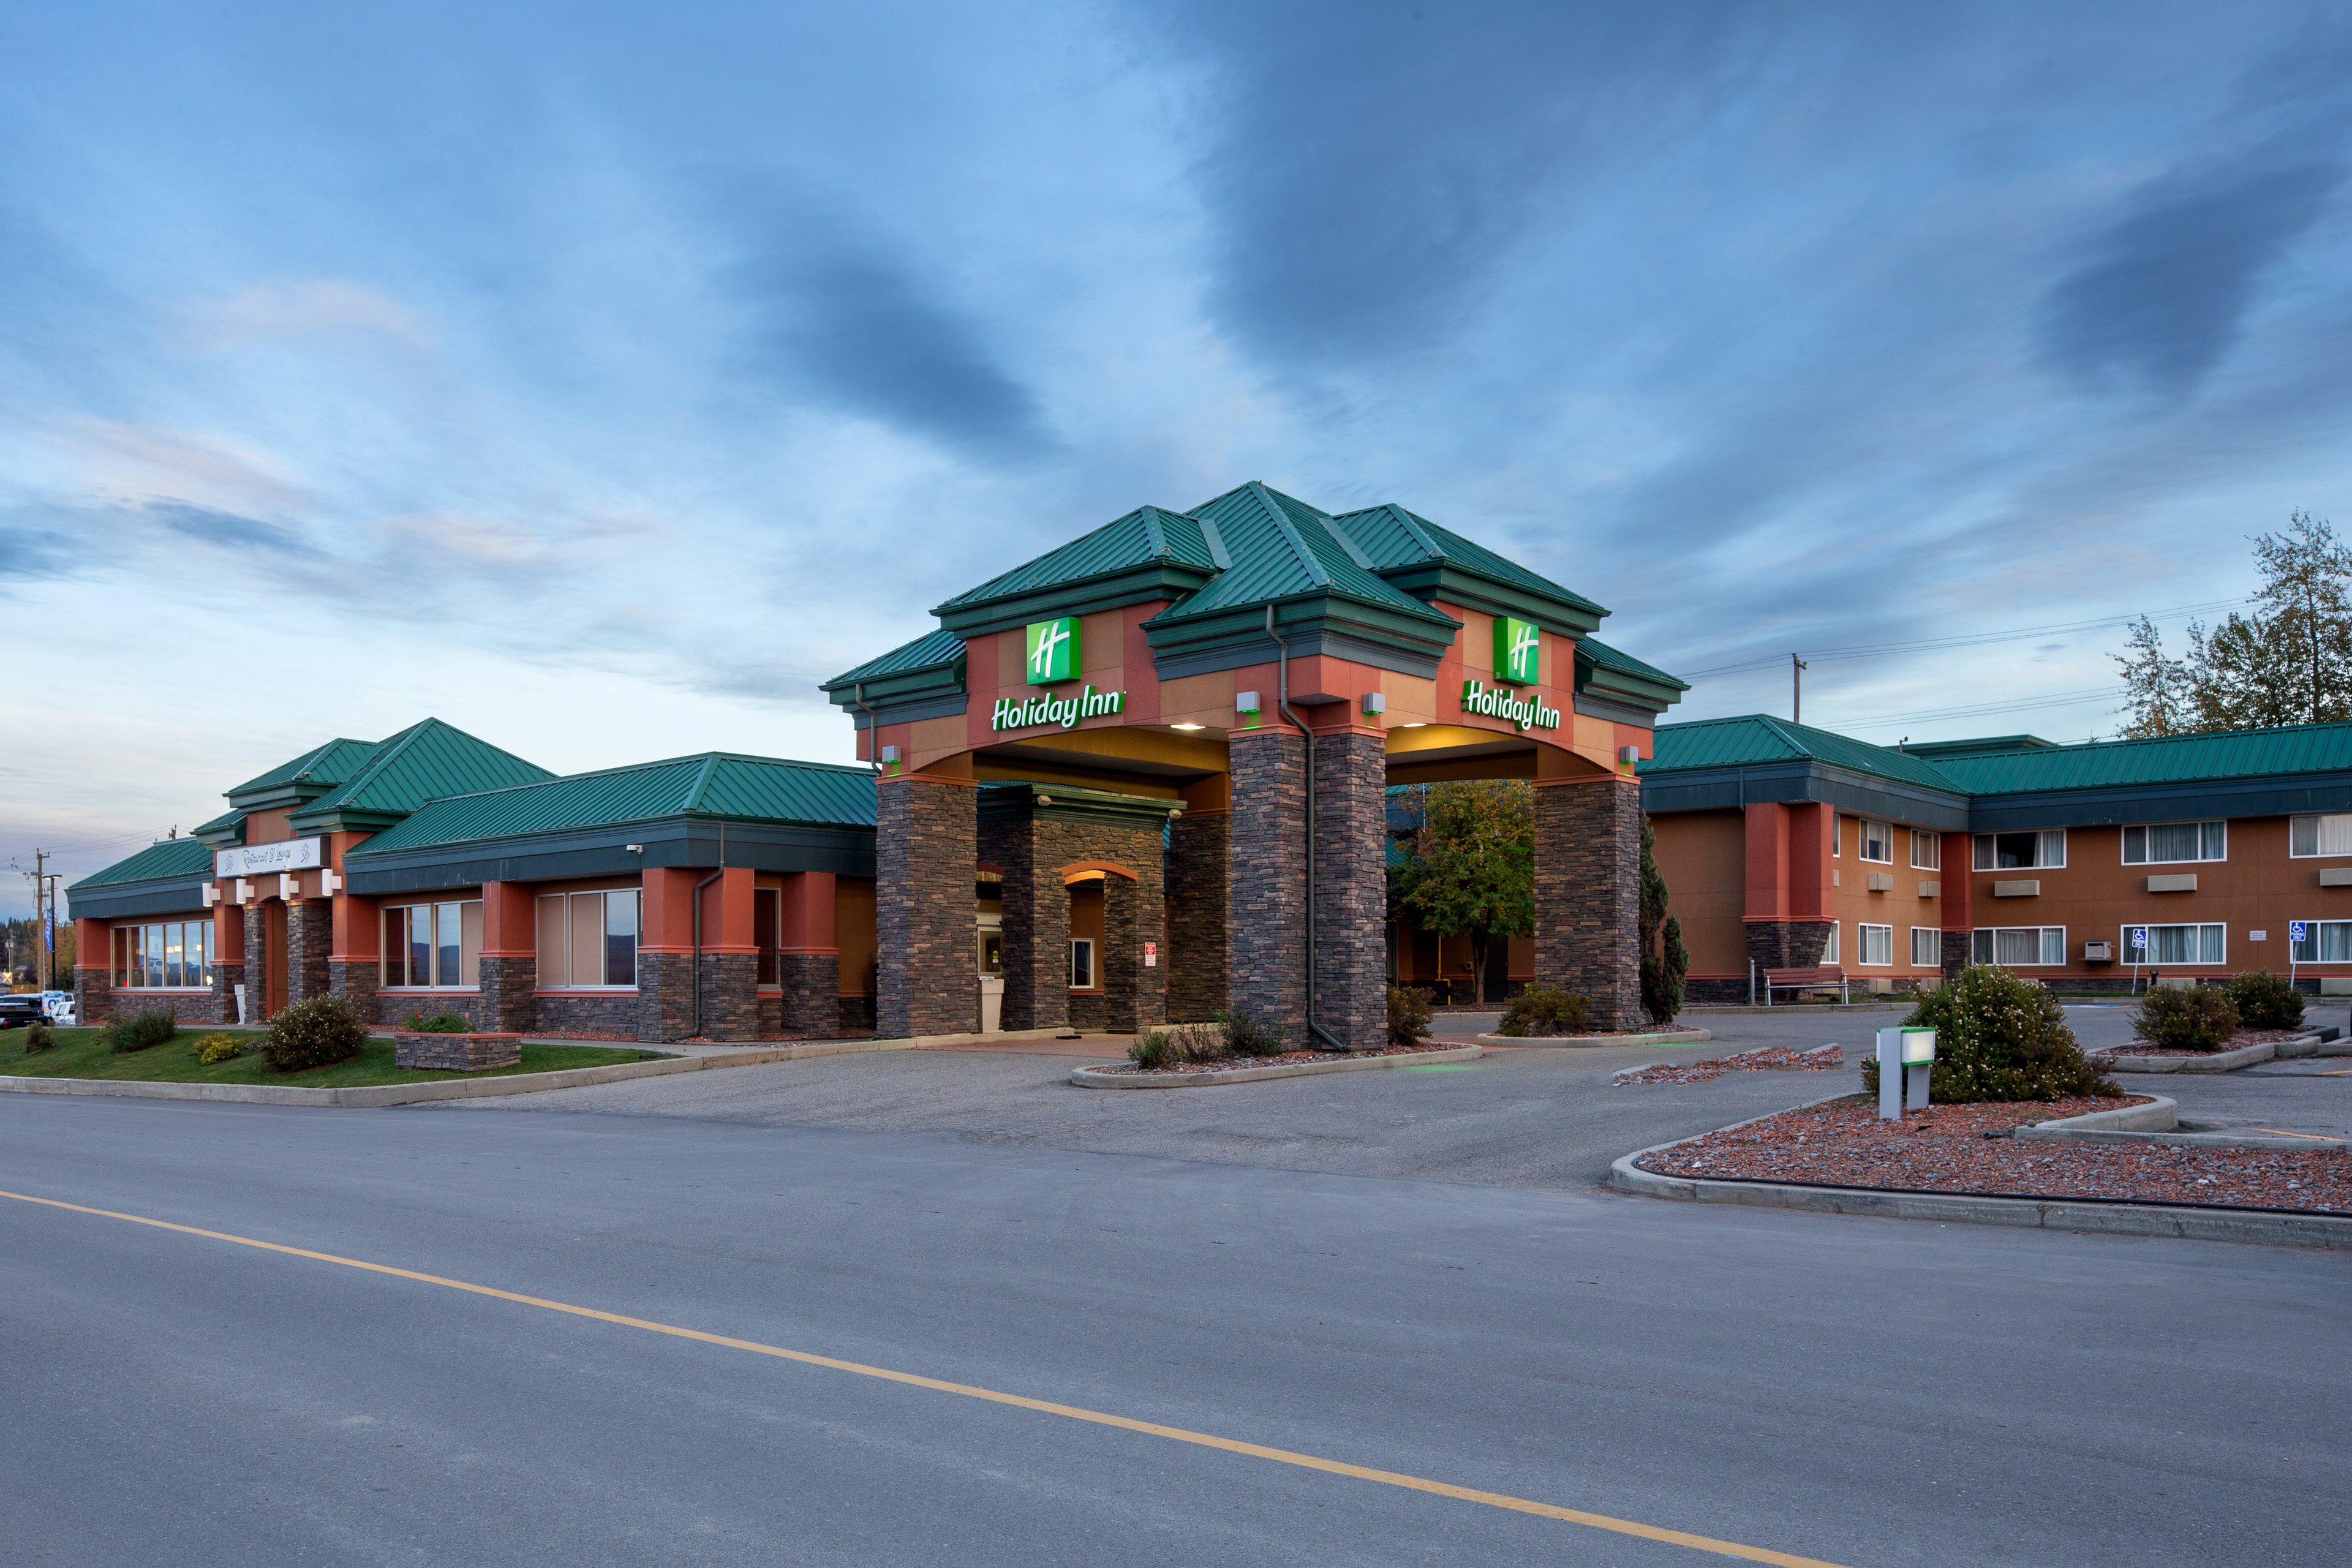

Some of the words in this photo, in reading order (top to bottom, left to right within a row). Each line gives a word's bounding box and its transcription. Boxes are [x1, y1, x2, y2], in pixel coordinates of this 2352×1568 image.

[991, 692, 1079, 730] Holiday
[1081, 685, 1120, 717] Inn
[1468, 680, 1534, 730] Holiday
[1536, 695, 1560, 729] Inn
[242, 850, 268, 869] Restaurant
[276, 844, 292, 868] Lounge
